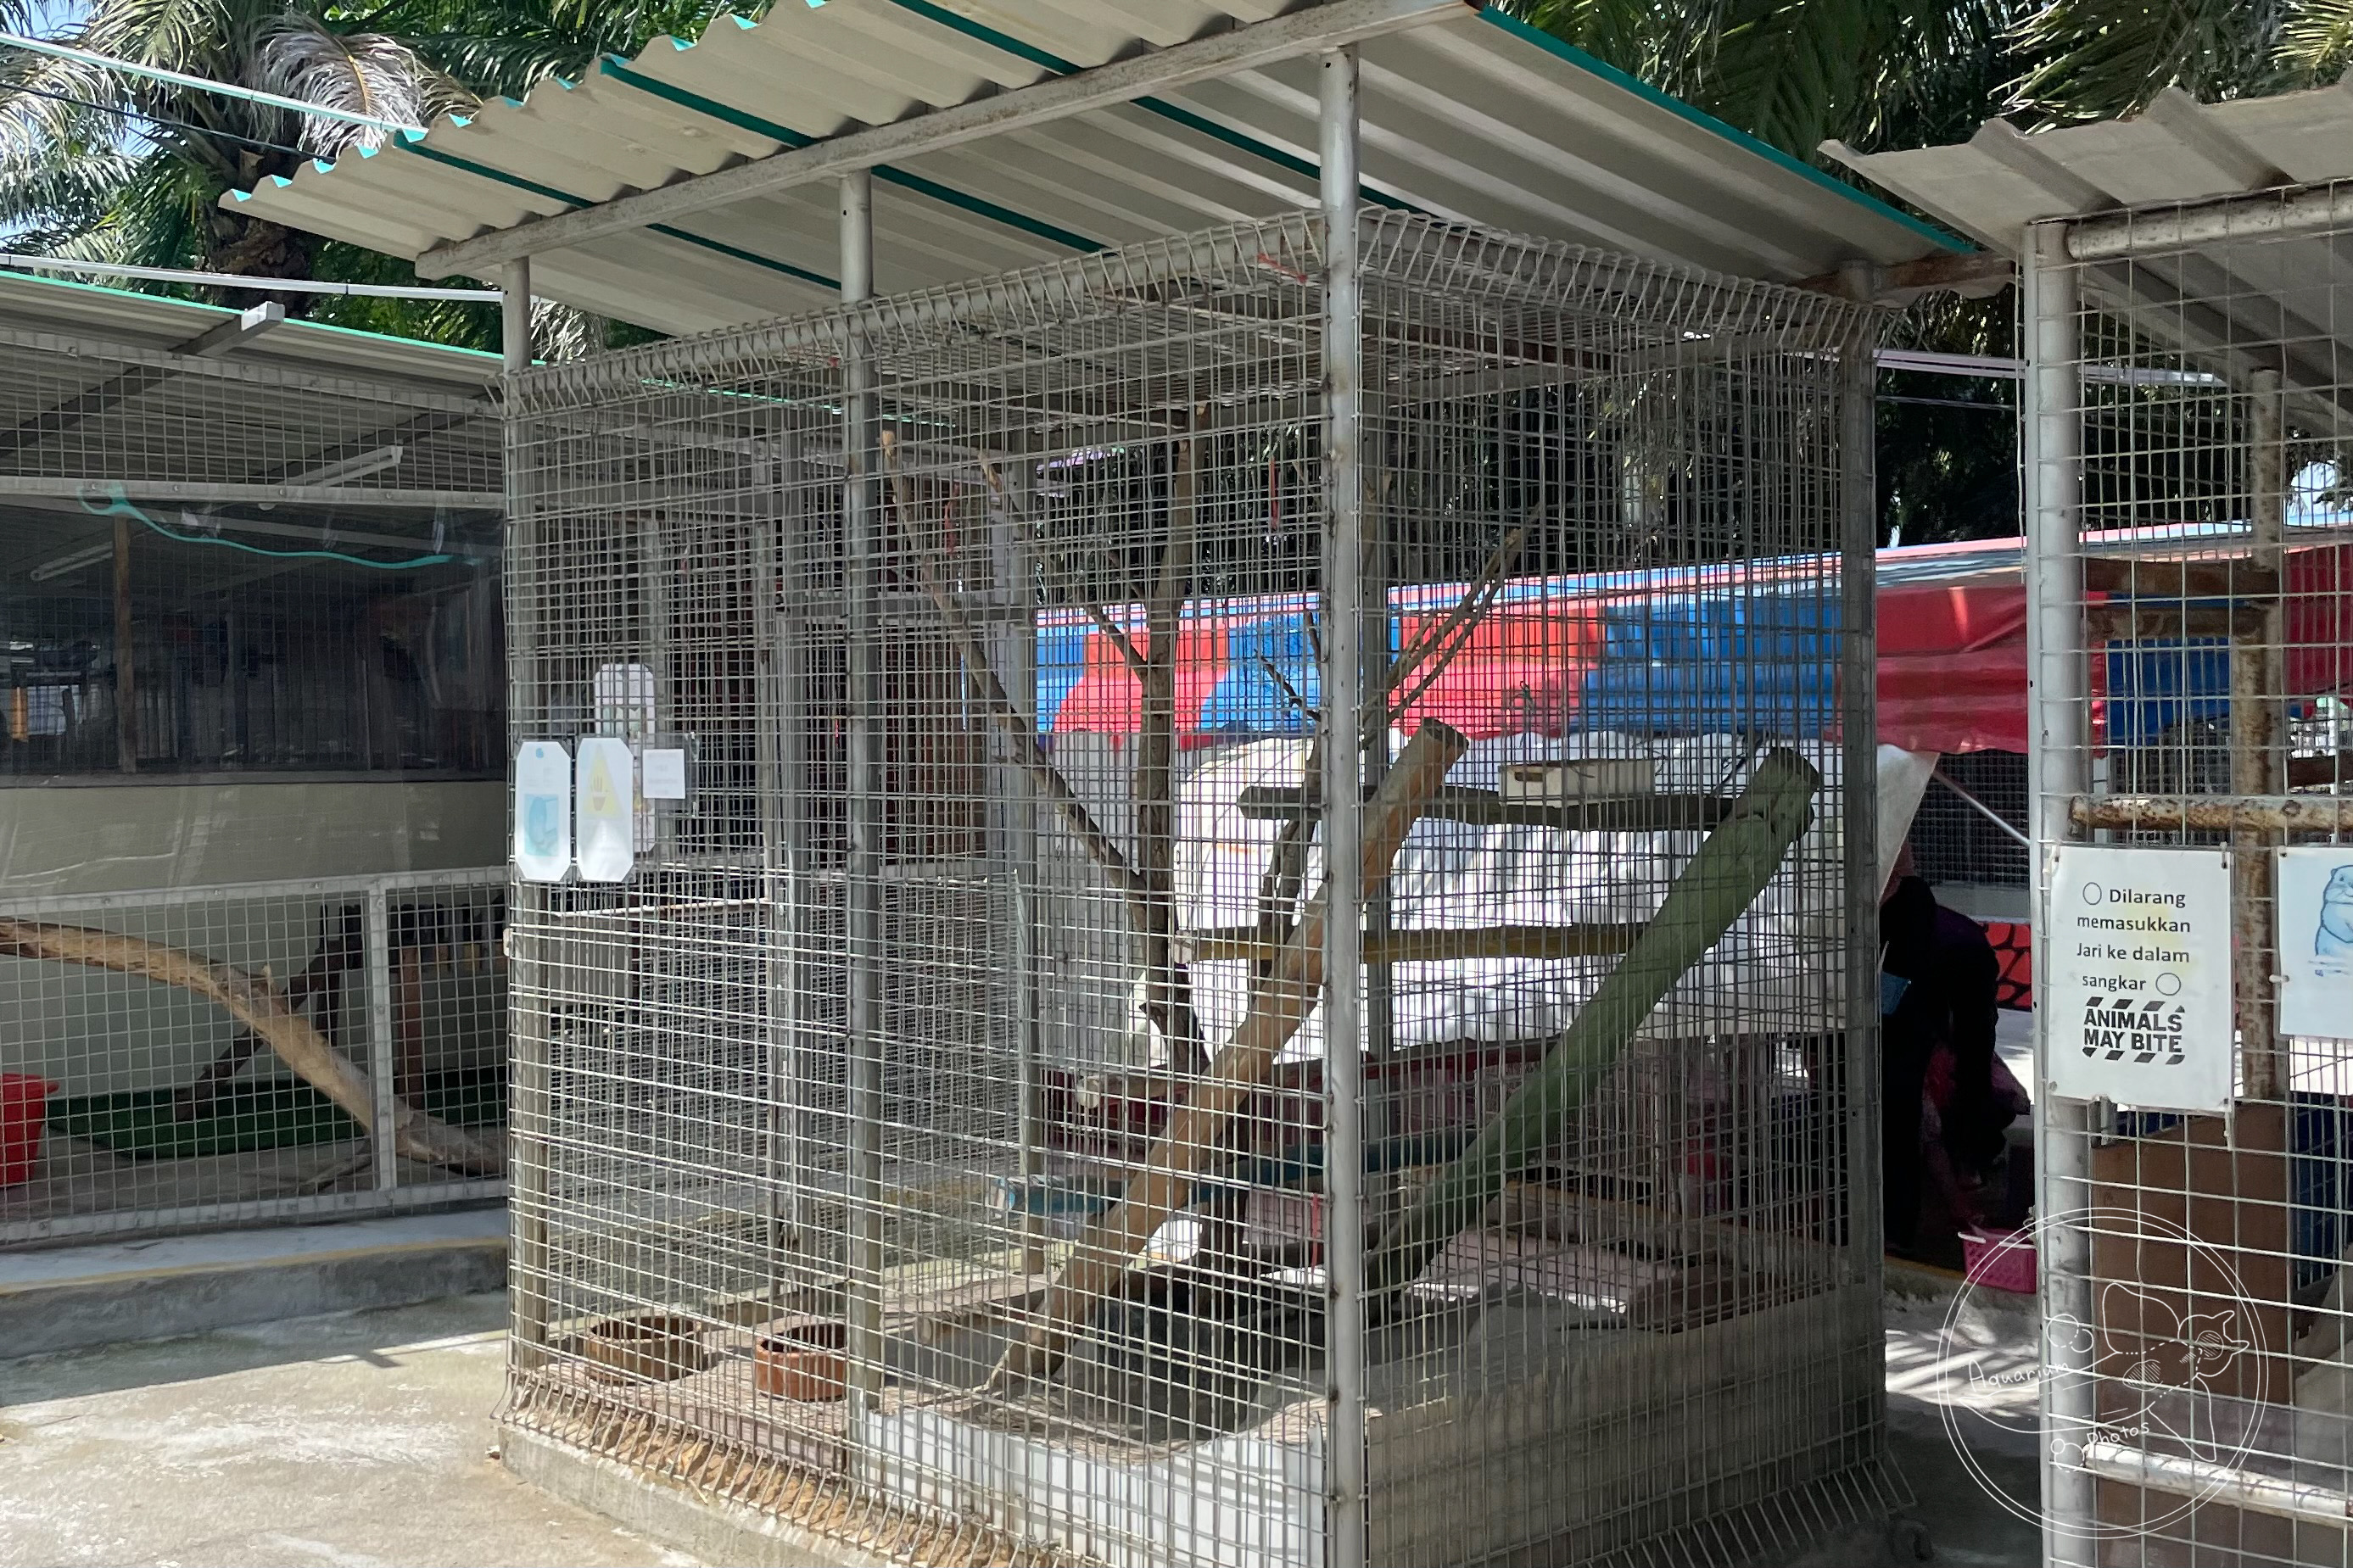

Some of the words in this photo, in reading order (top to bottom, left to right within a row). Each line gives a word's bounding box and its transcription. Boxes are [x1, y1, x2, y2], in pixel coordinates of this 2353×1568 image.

[2109, 889, 2186, 908] Dilarang
[2076, 917, 2191, 933] memasukkan
[2076, 943, 2102, 959] Jari
[2108, 945, 2127, 960] ke
[2132, 946, 2190, 963] dalam
[2082, 974, 2147, 992] sangkar
[2083, 1008, 2183, 1032] ANIMALS
[2084, 1029, 2125, 1049] MAY
[2132, 1033, 2183, 1053] BITE
